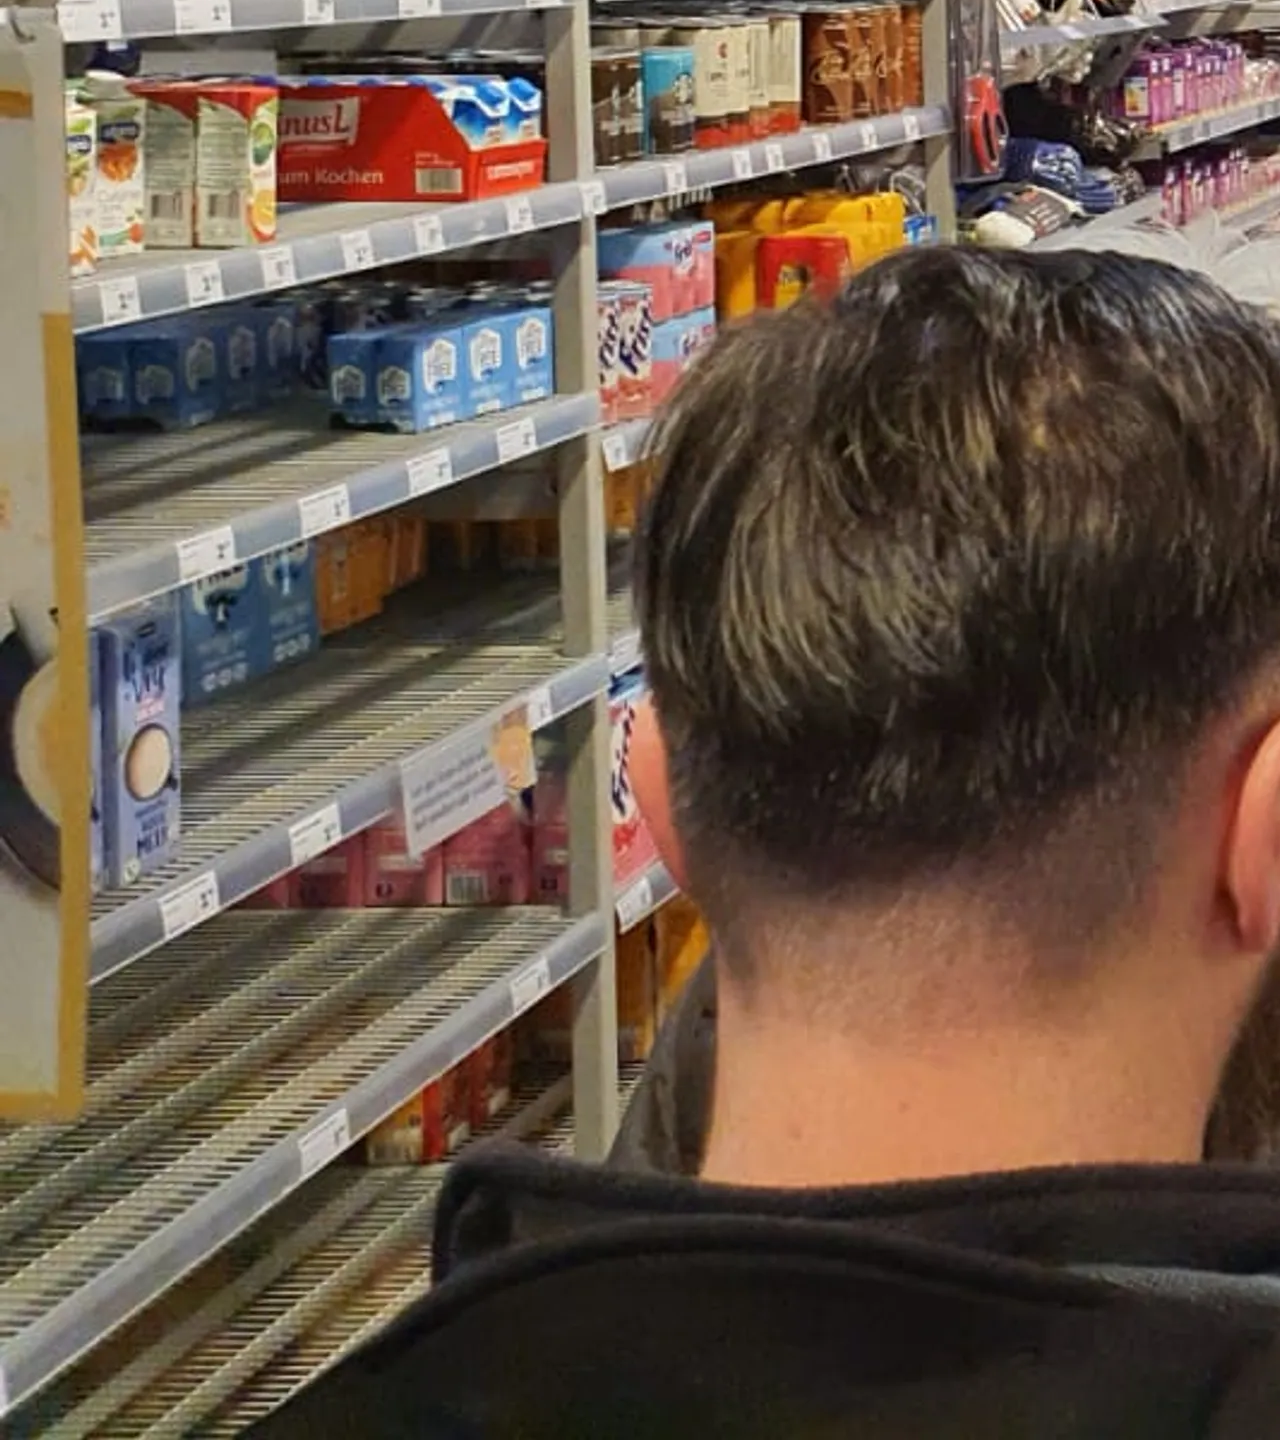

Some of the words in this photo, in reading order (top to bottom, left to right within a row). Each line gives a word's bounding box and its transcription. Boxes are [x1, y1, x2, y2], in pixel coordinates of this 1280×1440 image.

[279, 103, 350, 136] nusL
[279, 169, 309, 184] um
[314, 167, 384, 185] Kochen
